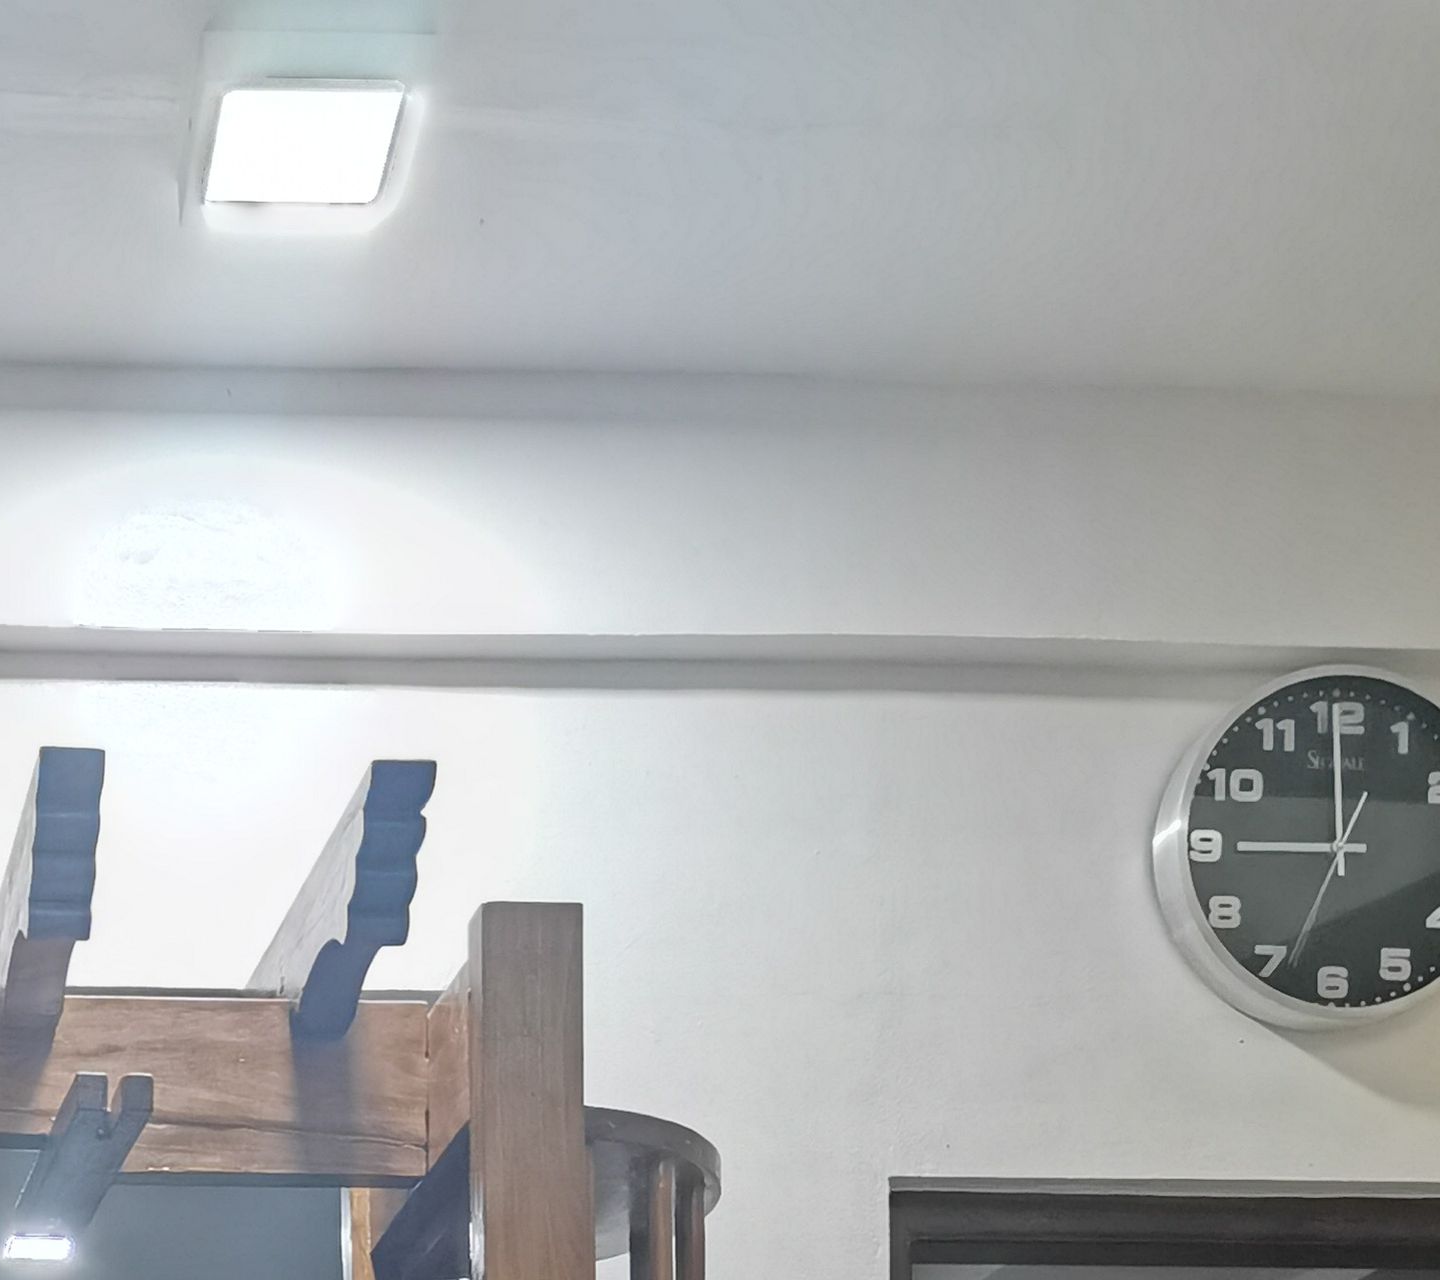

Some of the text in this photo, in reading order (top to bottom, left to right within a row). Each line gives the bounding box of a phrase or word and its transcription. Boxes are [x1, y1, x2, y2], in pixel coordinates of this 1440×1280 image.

[1309, 700, 1365, 735] 12
[1255, 718, 1295, 752] 11
[1390, 721, 1409, 754] 1
[1207, 768, 1264, 802] 10
[1189, 829, 1223, 862] 9
[1209, 896, 1242, 929] 8
[1254, 945, 1287, 978] 7
[1379, 947, 1411, 981] 5
[1317, 966, 1349, 999] 6
